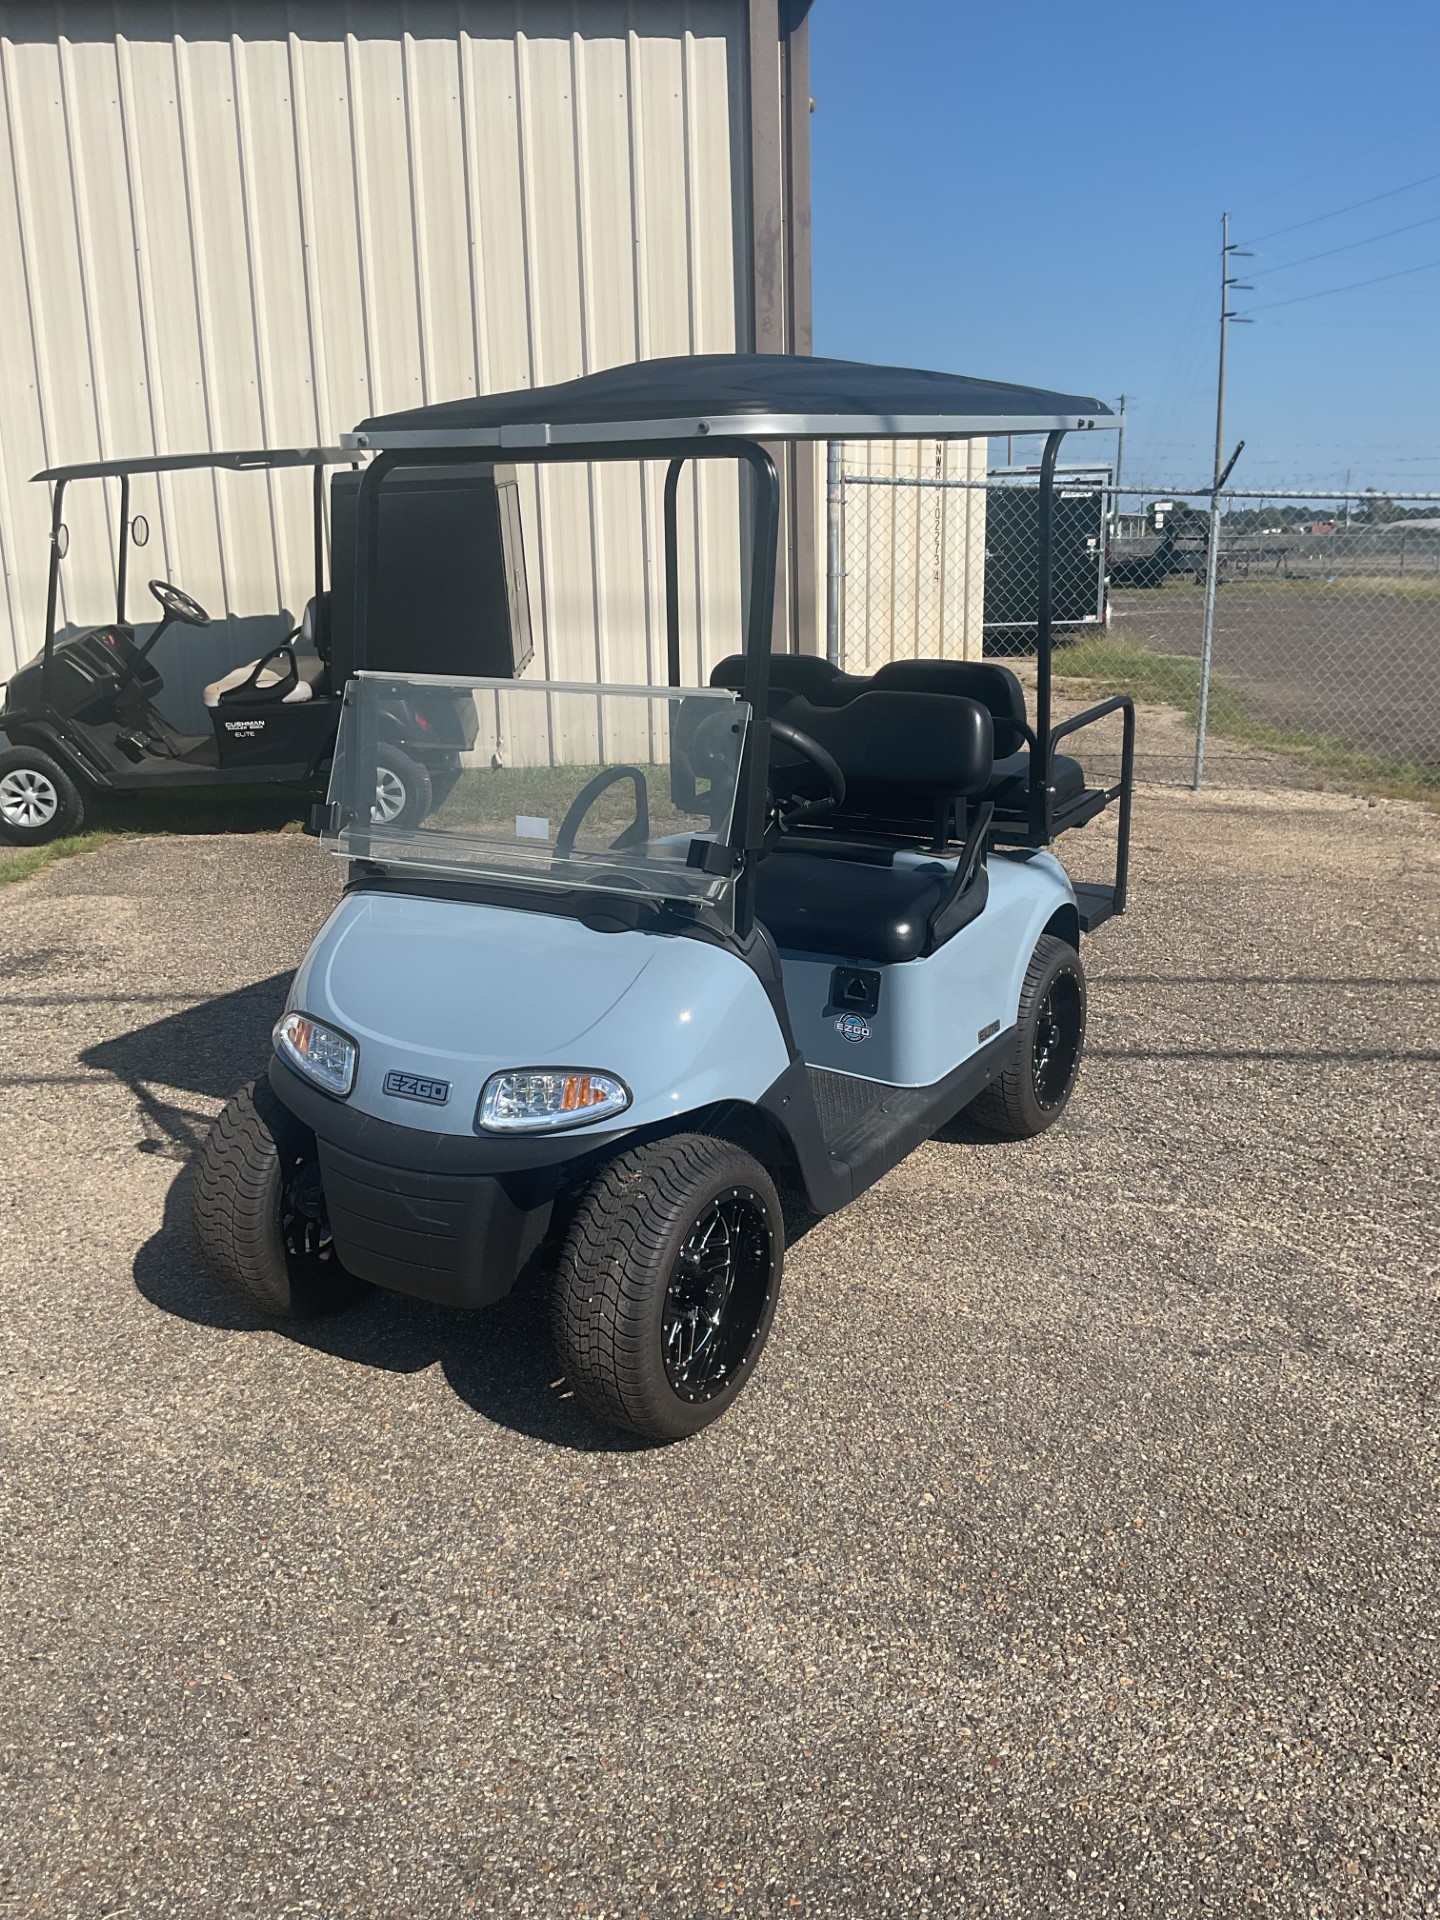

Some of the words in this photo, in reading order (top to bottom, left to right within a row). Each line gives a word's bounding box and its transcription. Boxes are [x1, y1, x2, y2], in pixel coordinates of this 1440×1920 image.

[225, 720, 265, 728] CUSHMAN
[836, 1022, 870, 1036] EZGO
[388, 1073, 448, 1101] EZGO
